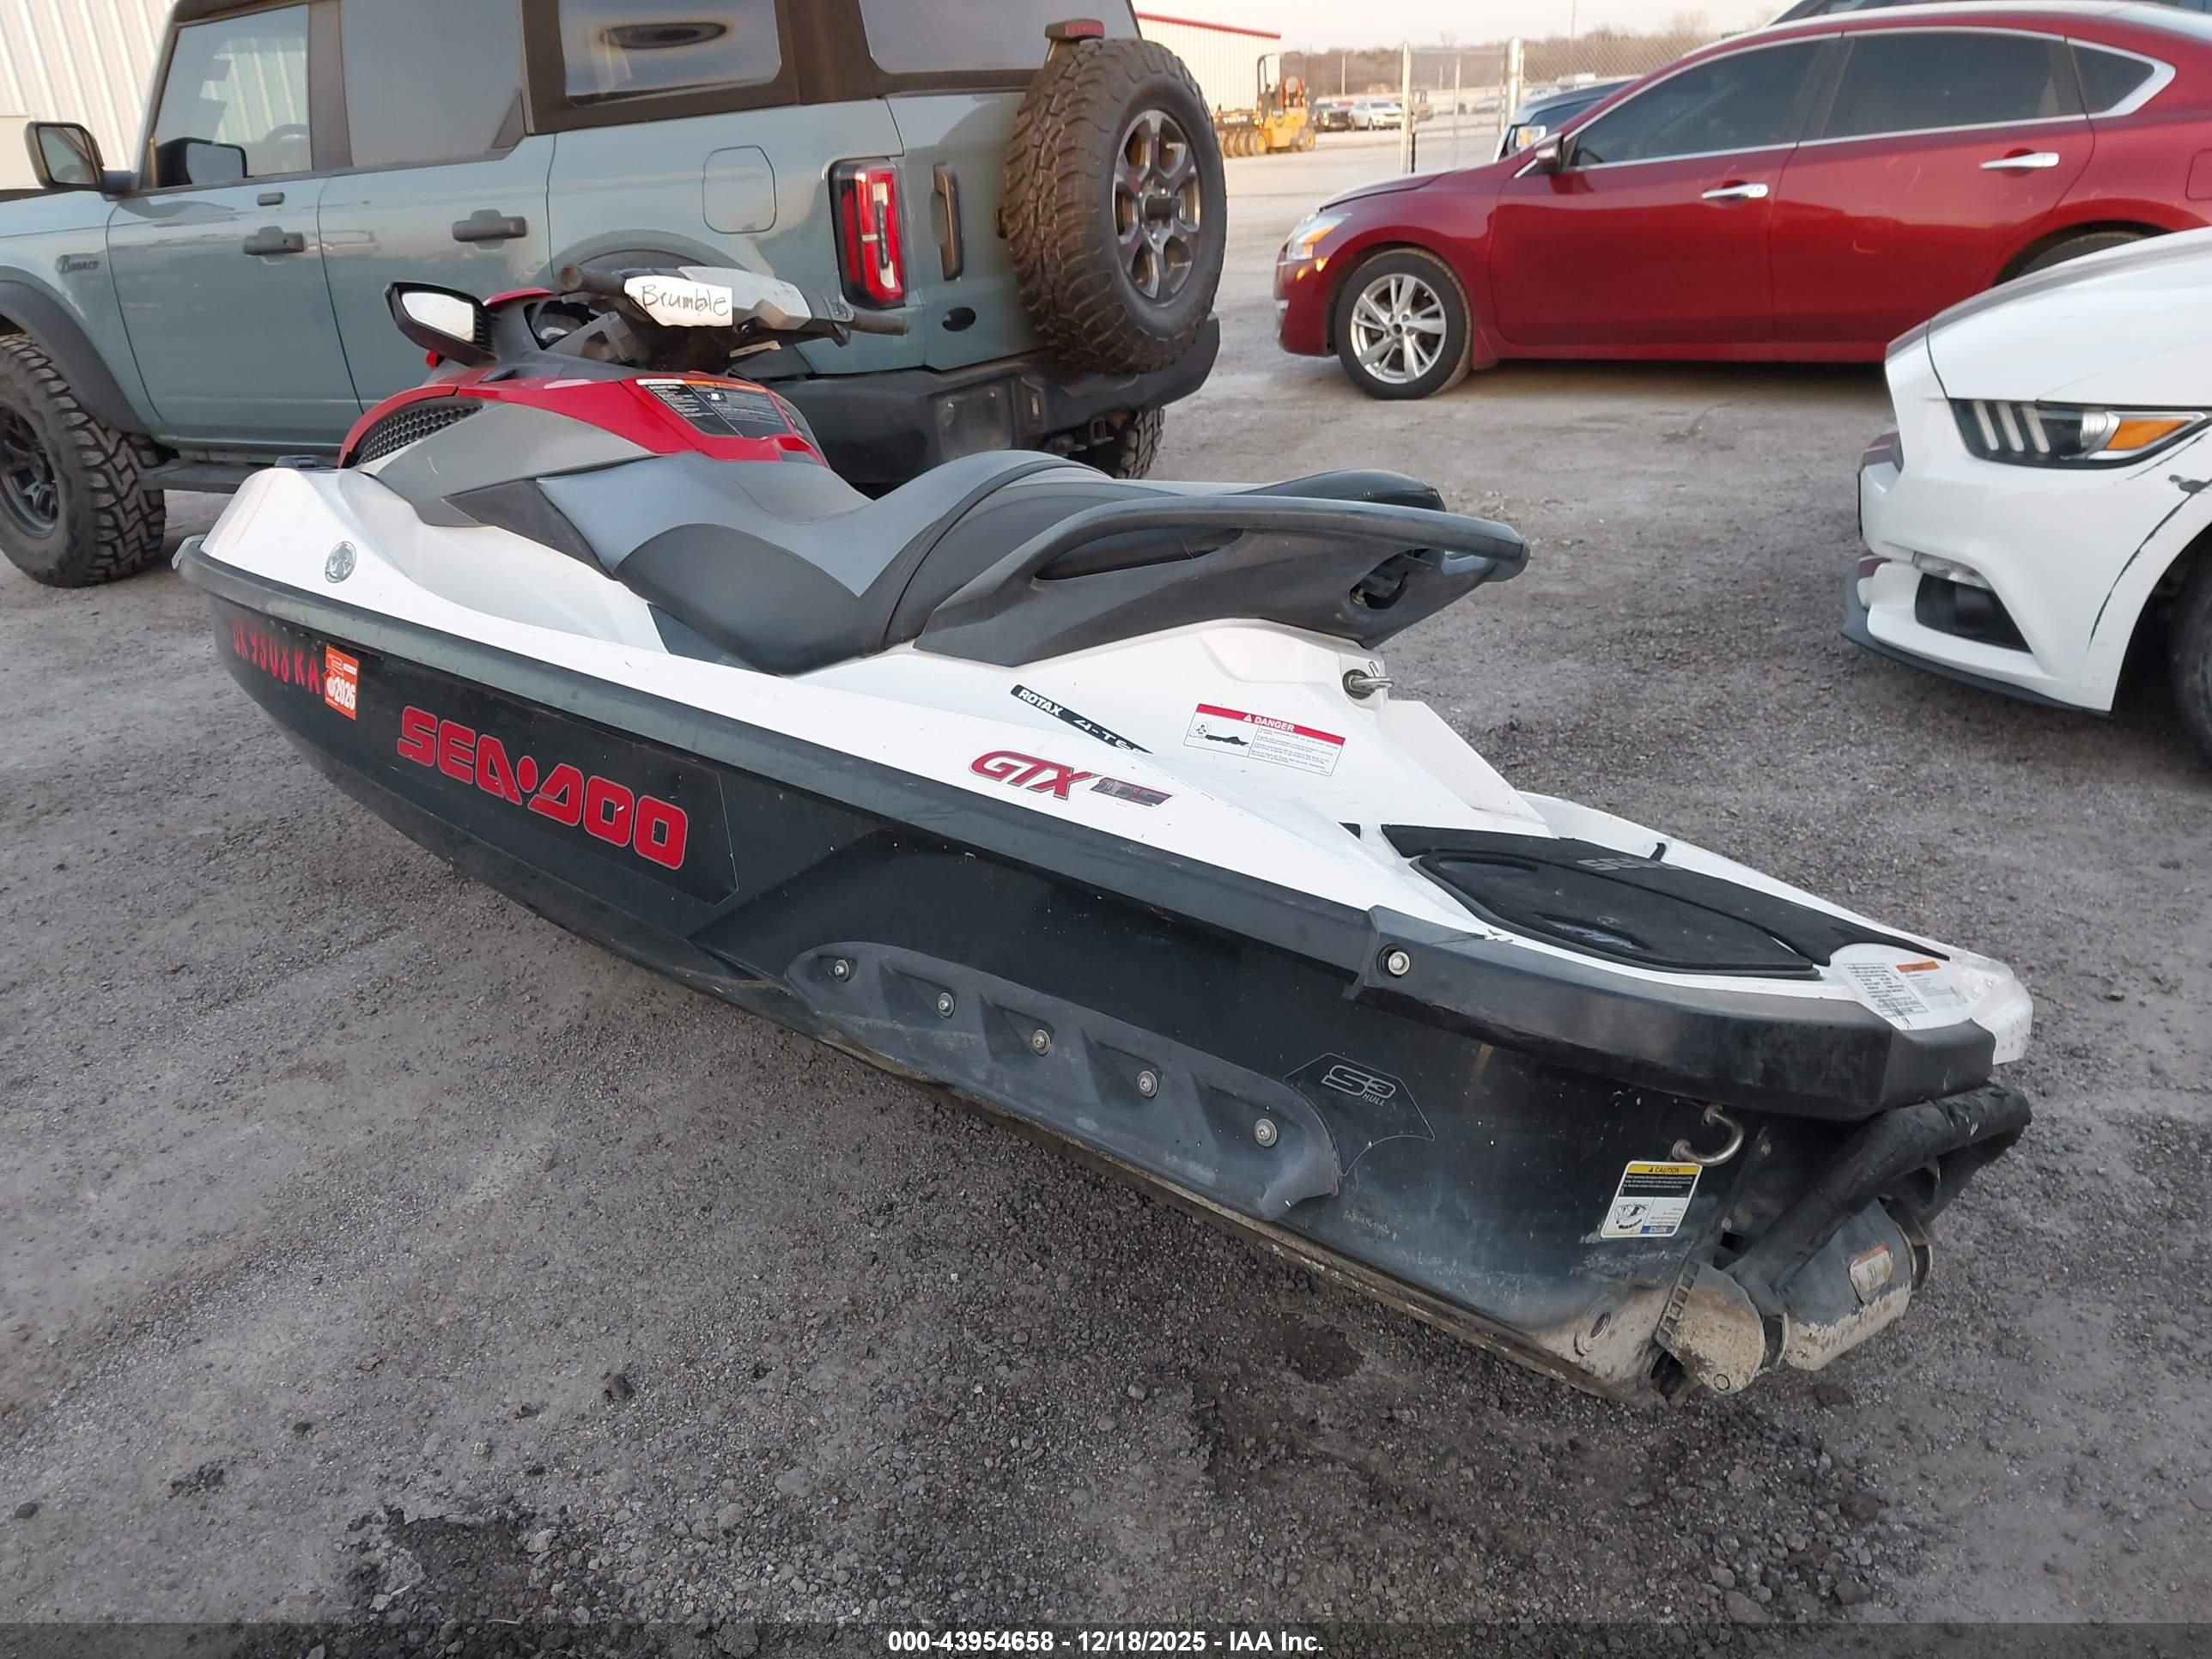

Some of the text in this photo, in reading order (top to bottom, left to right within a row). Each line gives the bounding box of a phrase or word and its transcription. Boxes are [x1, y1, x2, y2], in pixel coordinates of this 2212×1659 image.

[641, 284, 729, 317] Brumble
[1018, 689, 1064, 717] ROTAX
[1254, 716, 1296, 732] DANGER
[969, 750, 1103, 801] GTX
[1362, 1092, 1385, 1106] HULL
